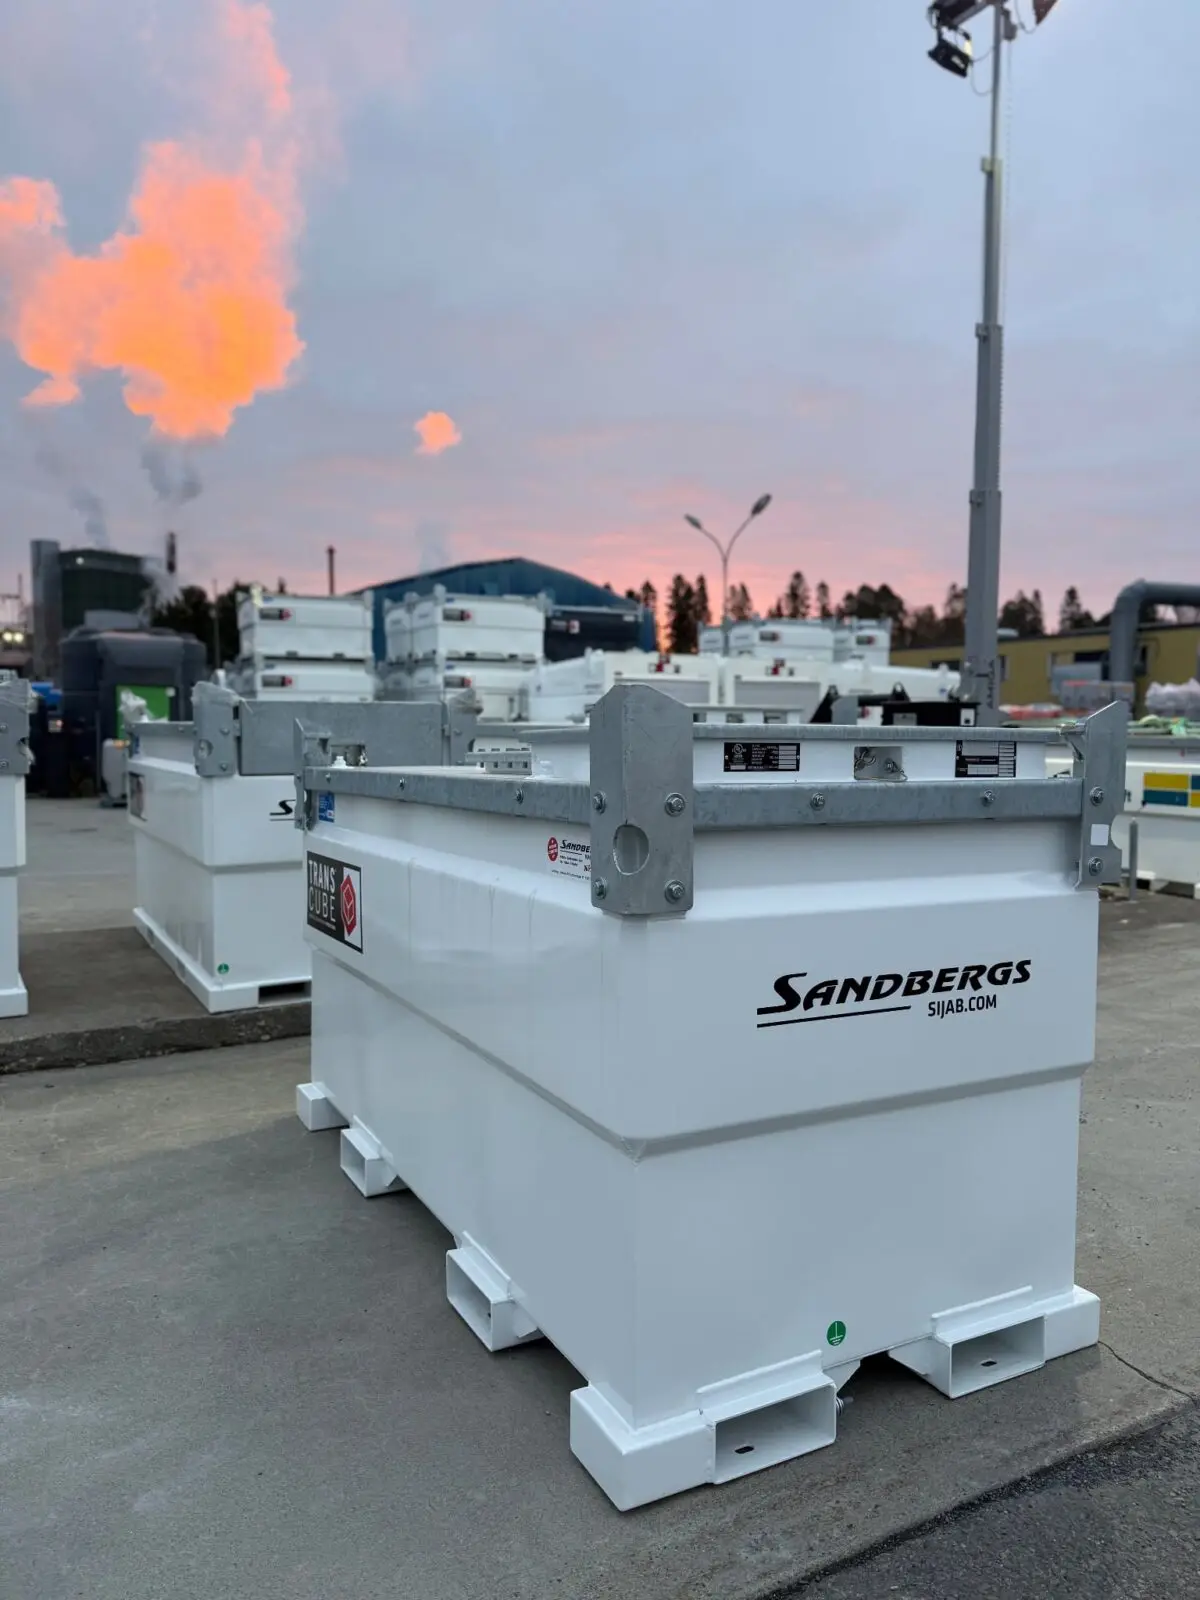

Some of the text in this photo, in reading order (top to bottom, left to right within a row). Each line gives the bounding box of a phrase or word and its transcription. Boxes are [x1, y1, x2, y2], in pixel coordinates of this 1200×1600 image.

[560, 839, 591, 854] SANDBE
[308, 859, 336, 894] TRANS
[308, 886, 336, 923] CUBE
[756, 959, 1031, 1016] SANDBERGS
[928, 994, 997, 1019] SIJAB.COM
